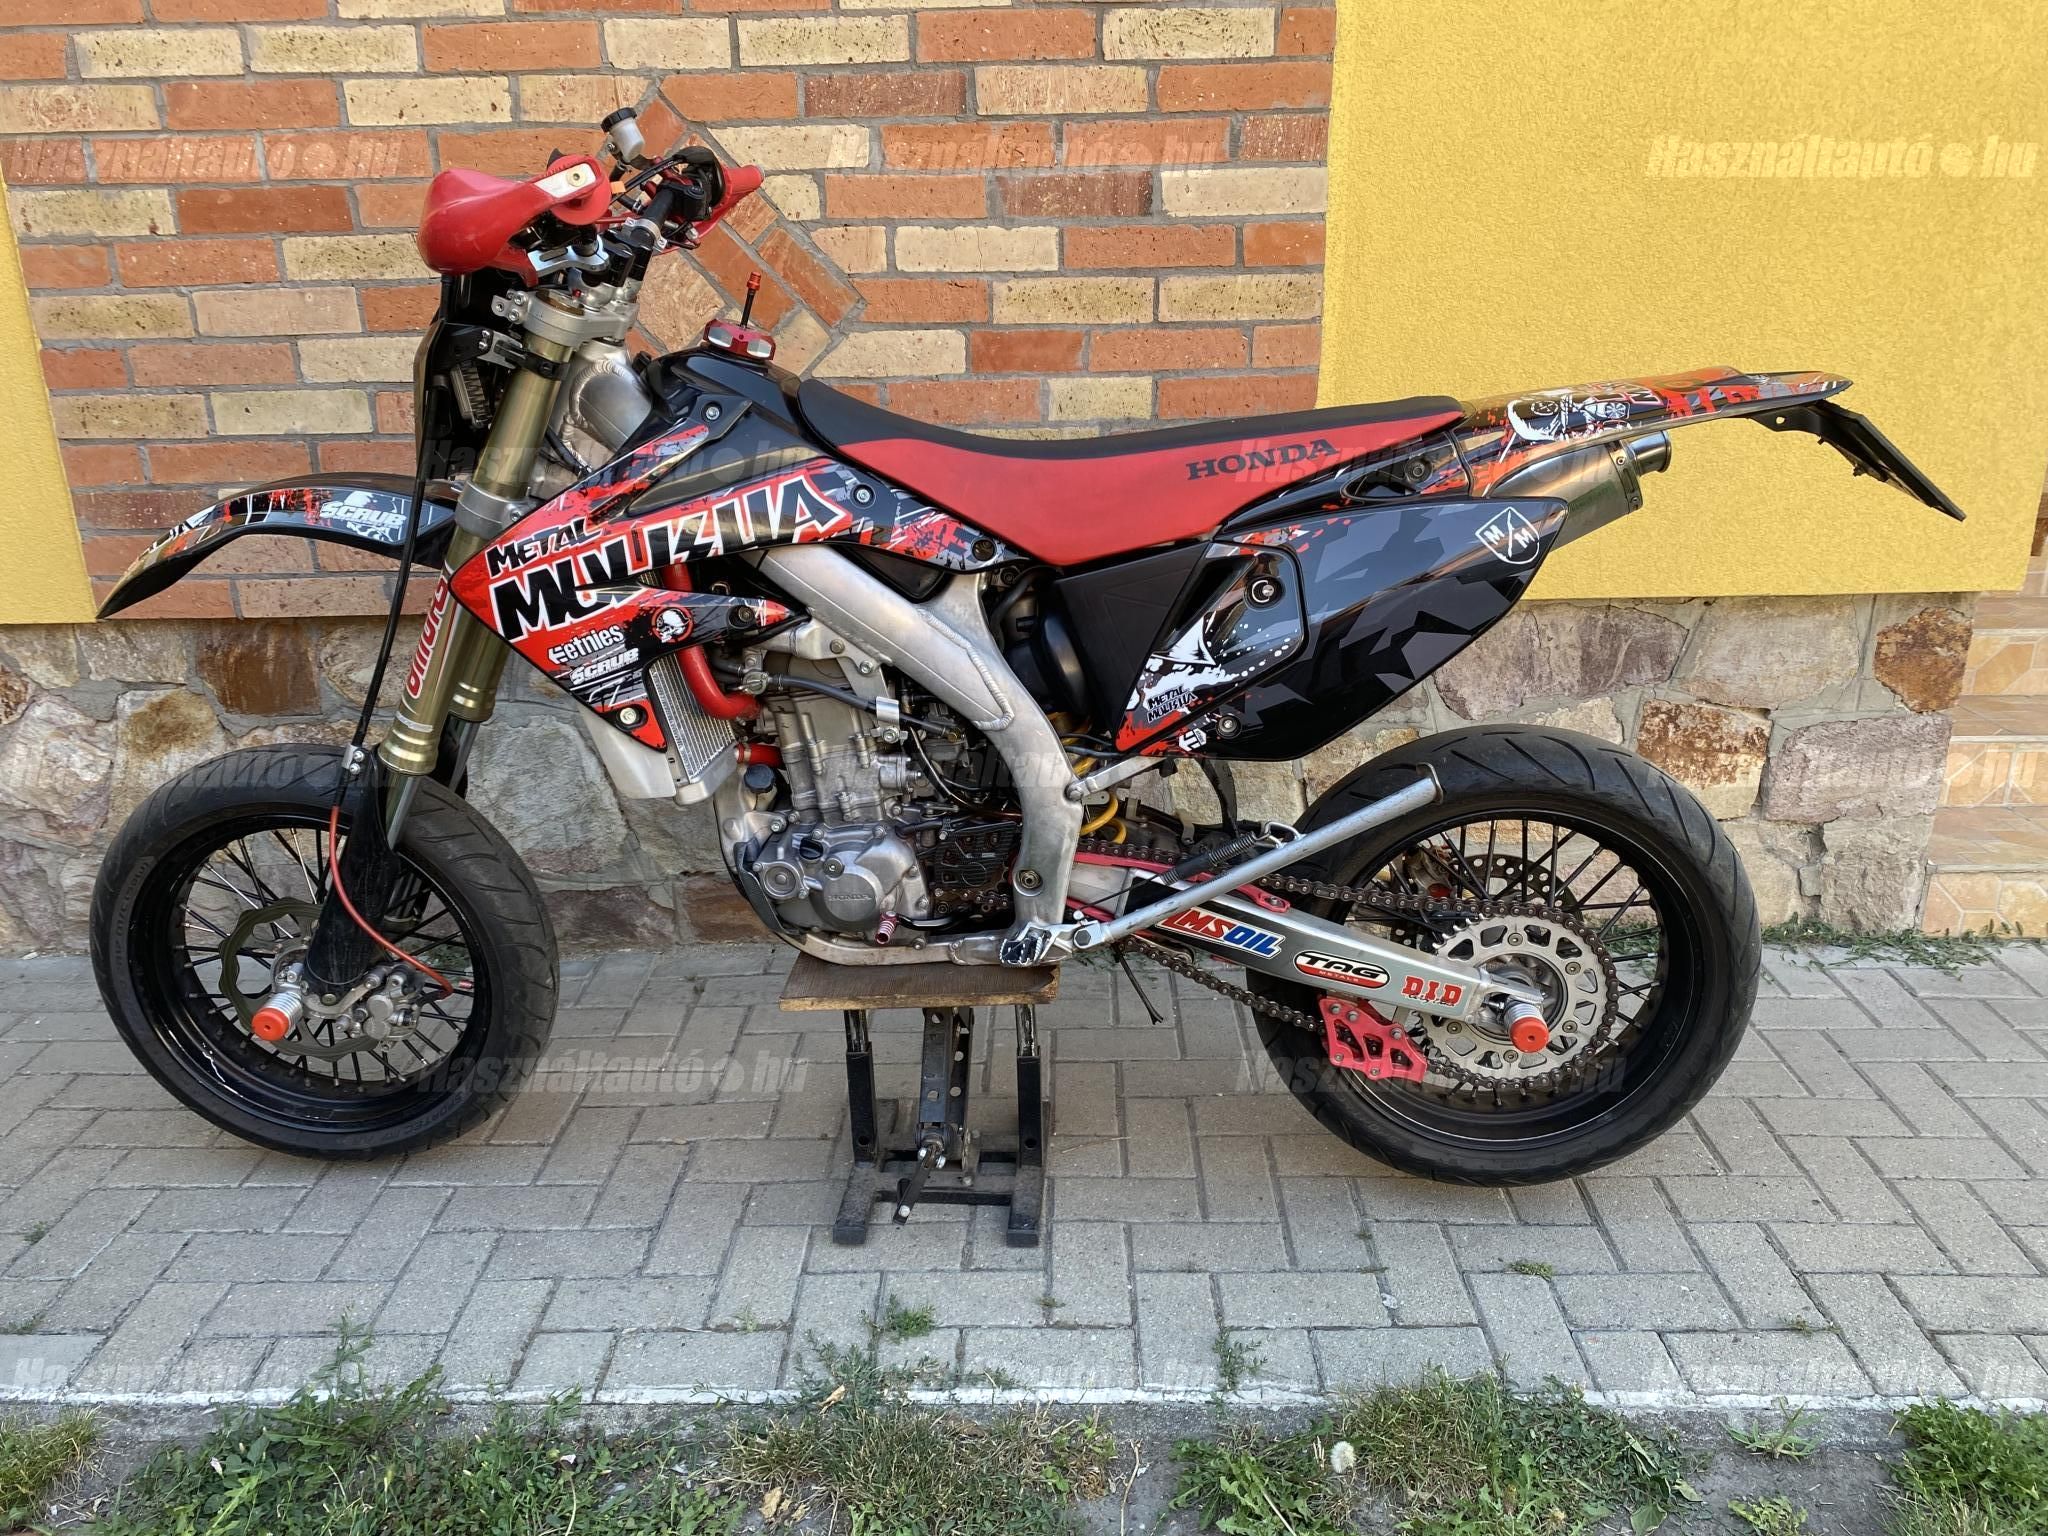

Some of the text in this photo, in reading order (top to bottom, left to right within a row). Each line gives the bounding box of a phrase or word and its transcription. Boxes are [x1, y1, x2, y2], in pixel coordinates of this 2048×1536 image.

[1186, 438, 1339, 480] HONDA
[320, 501, 407, 527] SCRUB
[485, 517, 602, 578] METAL
[562, 624, 625, 661] etnies
[570, 648, 639, 685] SCRUB
[1147, 685, 1187, 711] METAL
[1147, 692, 1198, 724] MULISHA
[1299, 952, 1381, 979] TAG
